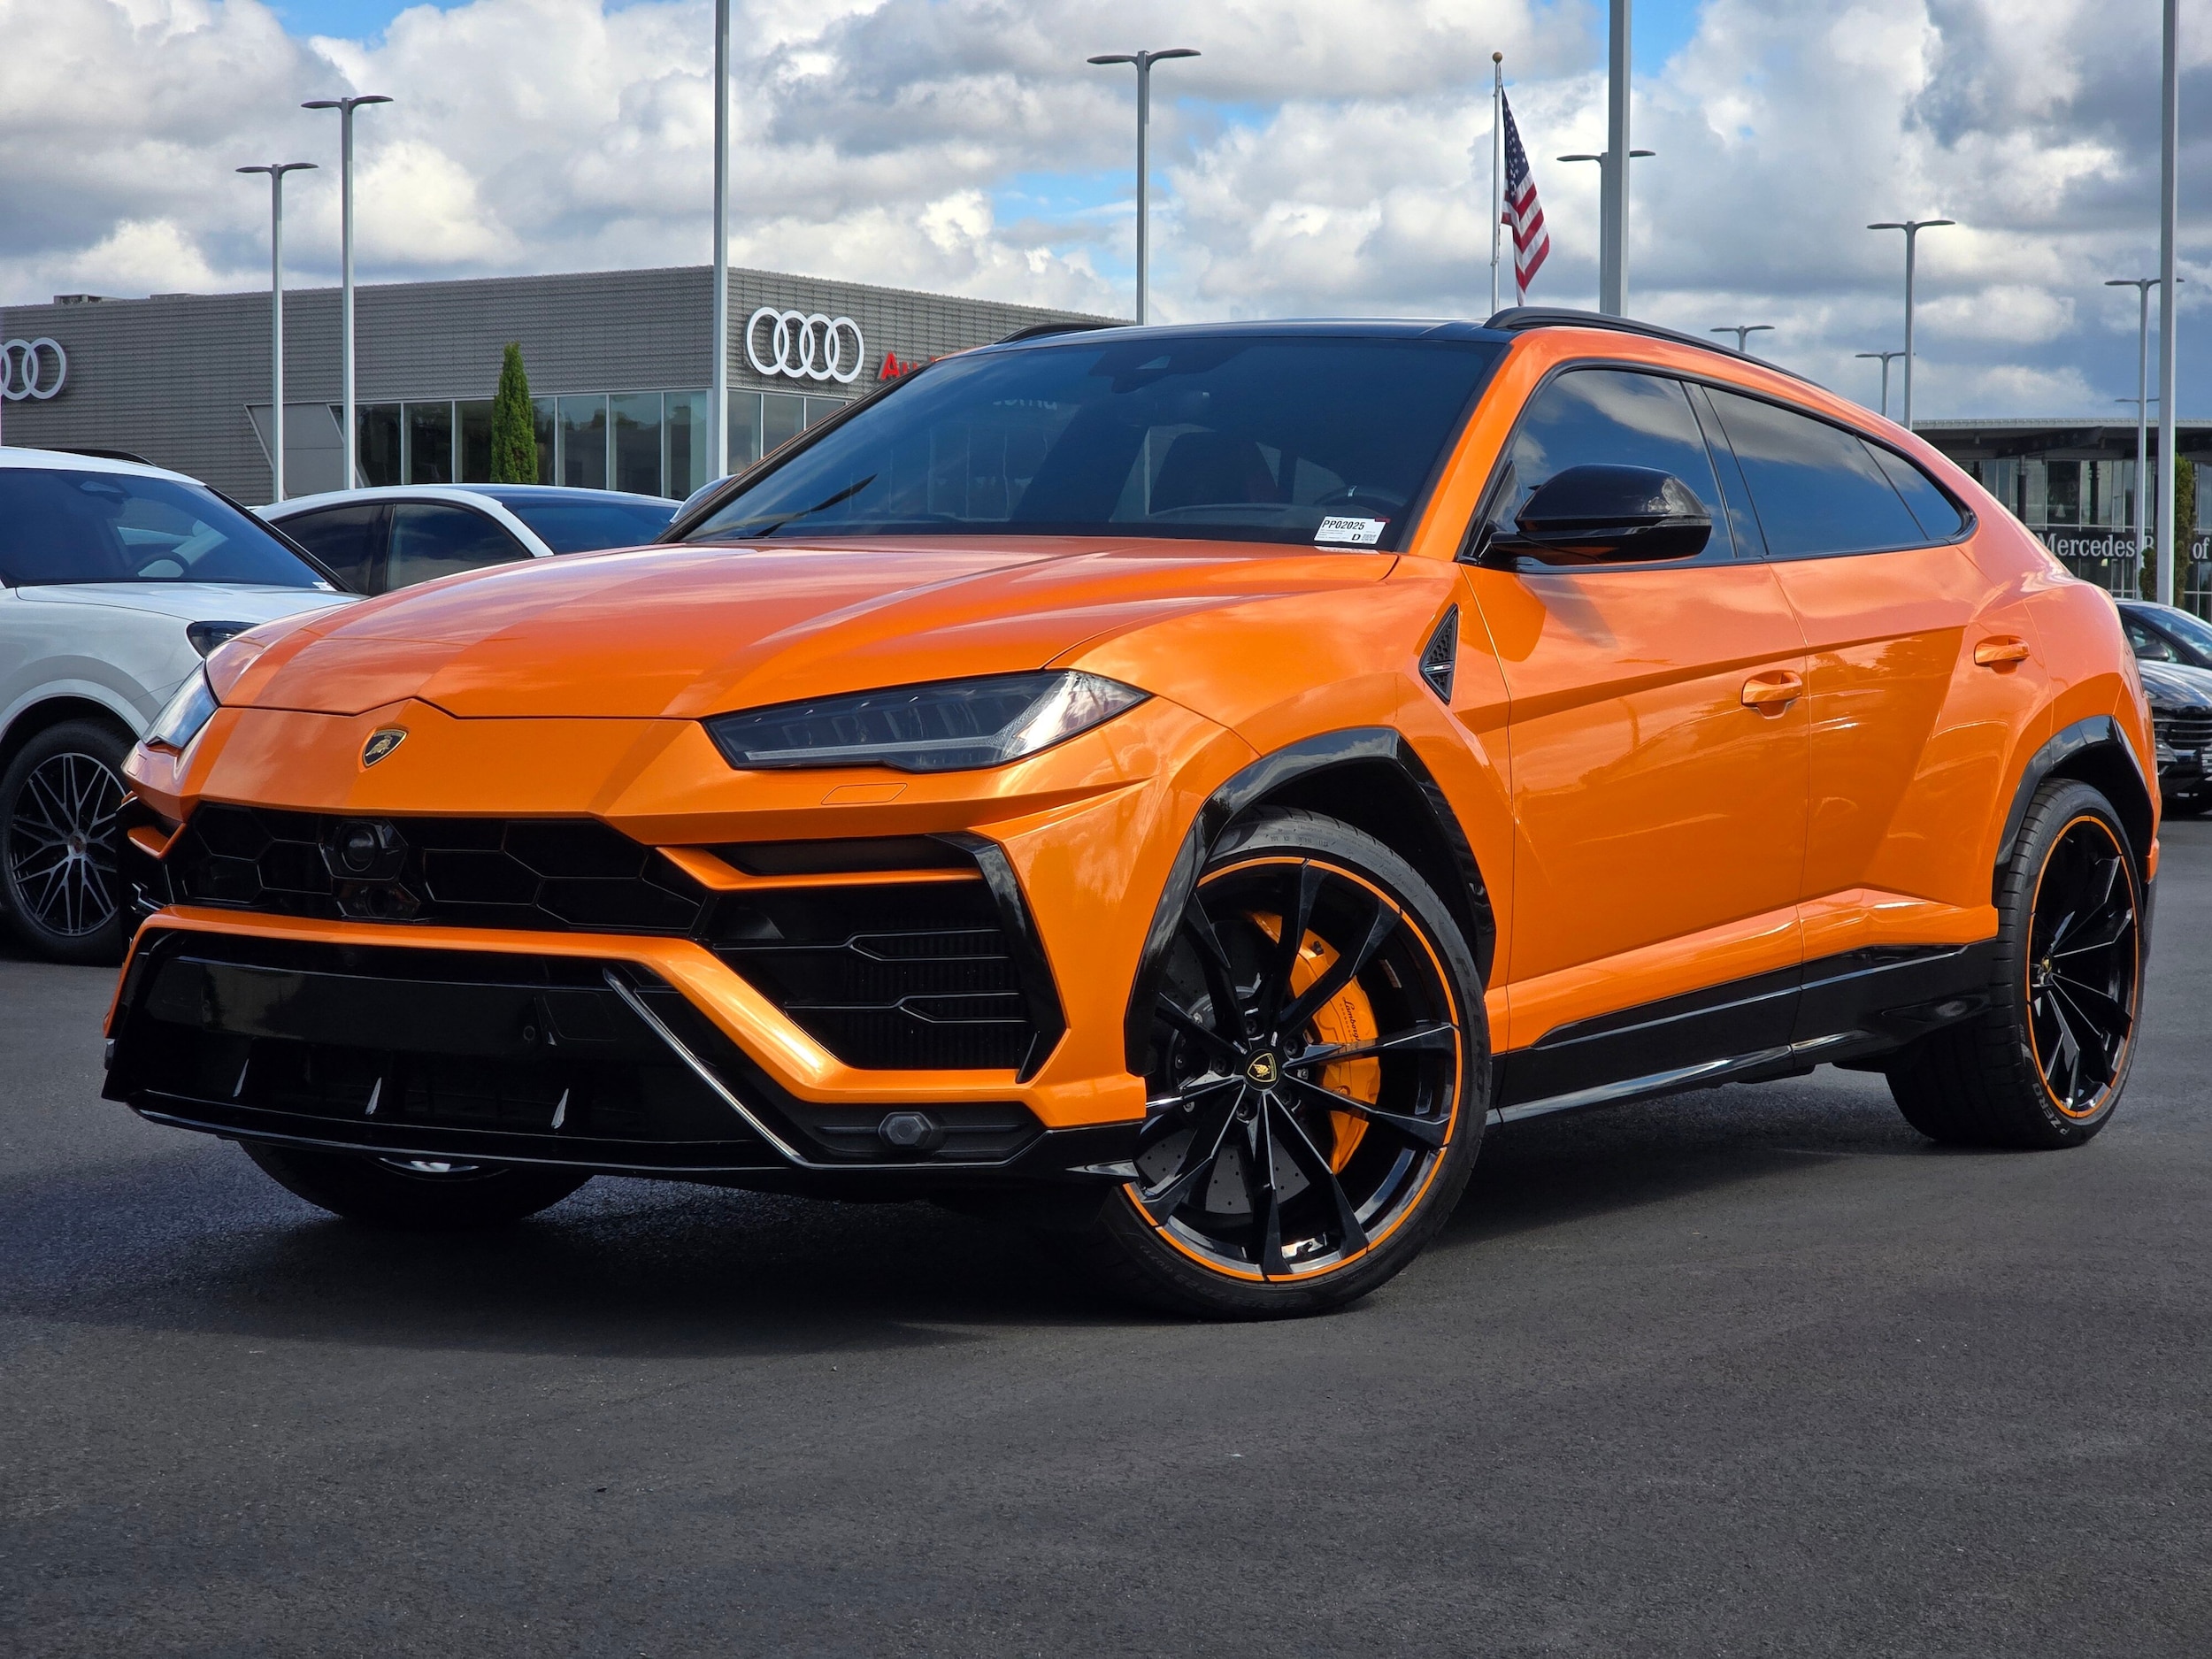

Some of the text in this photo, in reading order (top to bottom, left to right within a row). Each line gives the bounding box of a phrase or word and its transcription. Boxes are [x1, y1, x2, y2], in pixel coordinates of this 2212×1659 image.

[1321, 519, 1366, 531] PP02025
[1351, 533, 1362, 541] D
[2193, 536, 2210, 560] of
[1342, 995, 1362, 1042] Lamborg
[2032, 1081, 2062, 1130] ZERO
